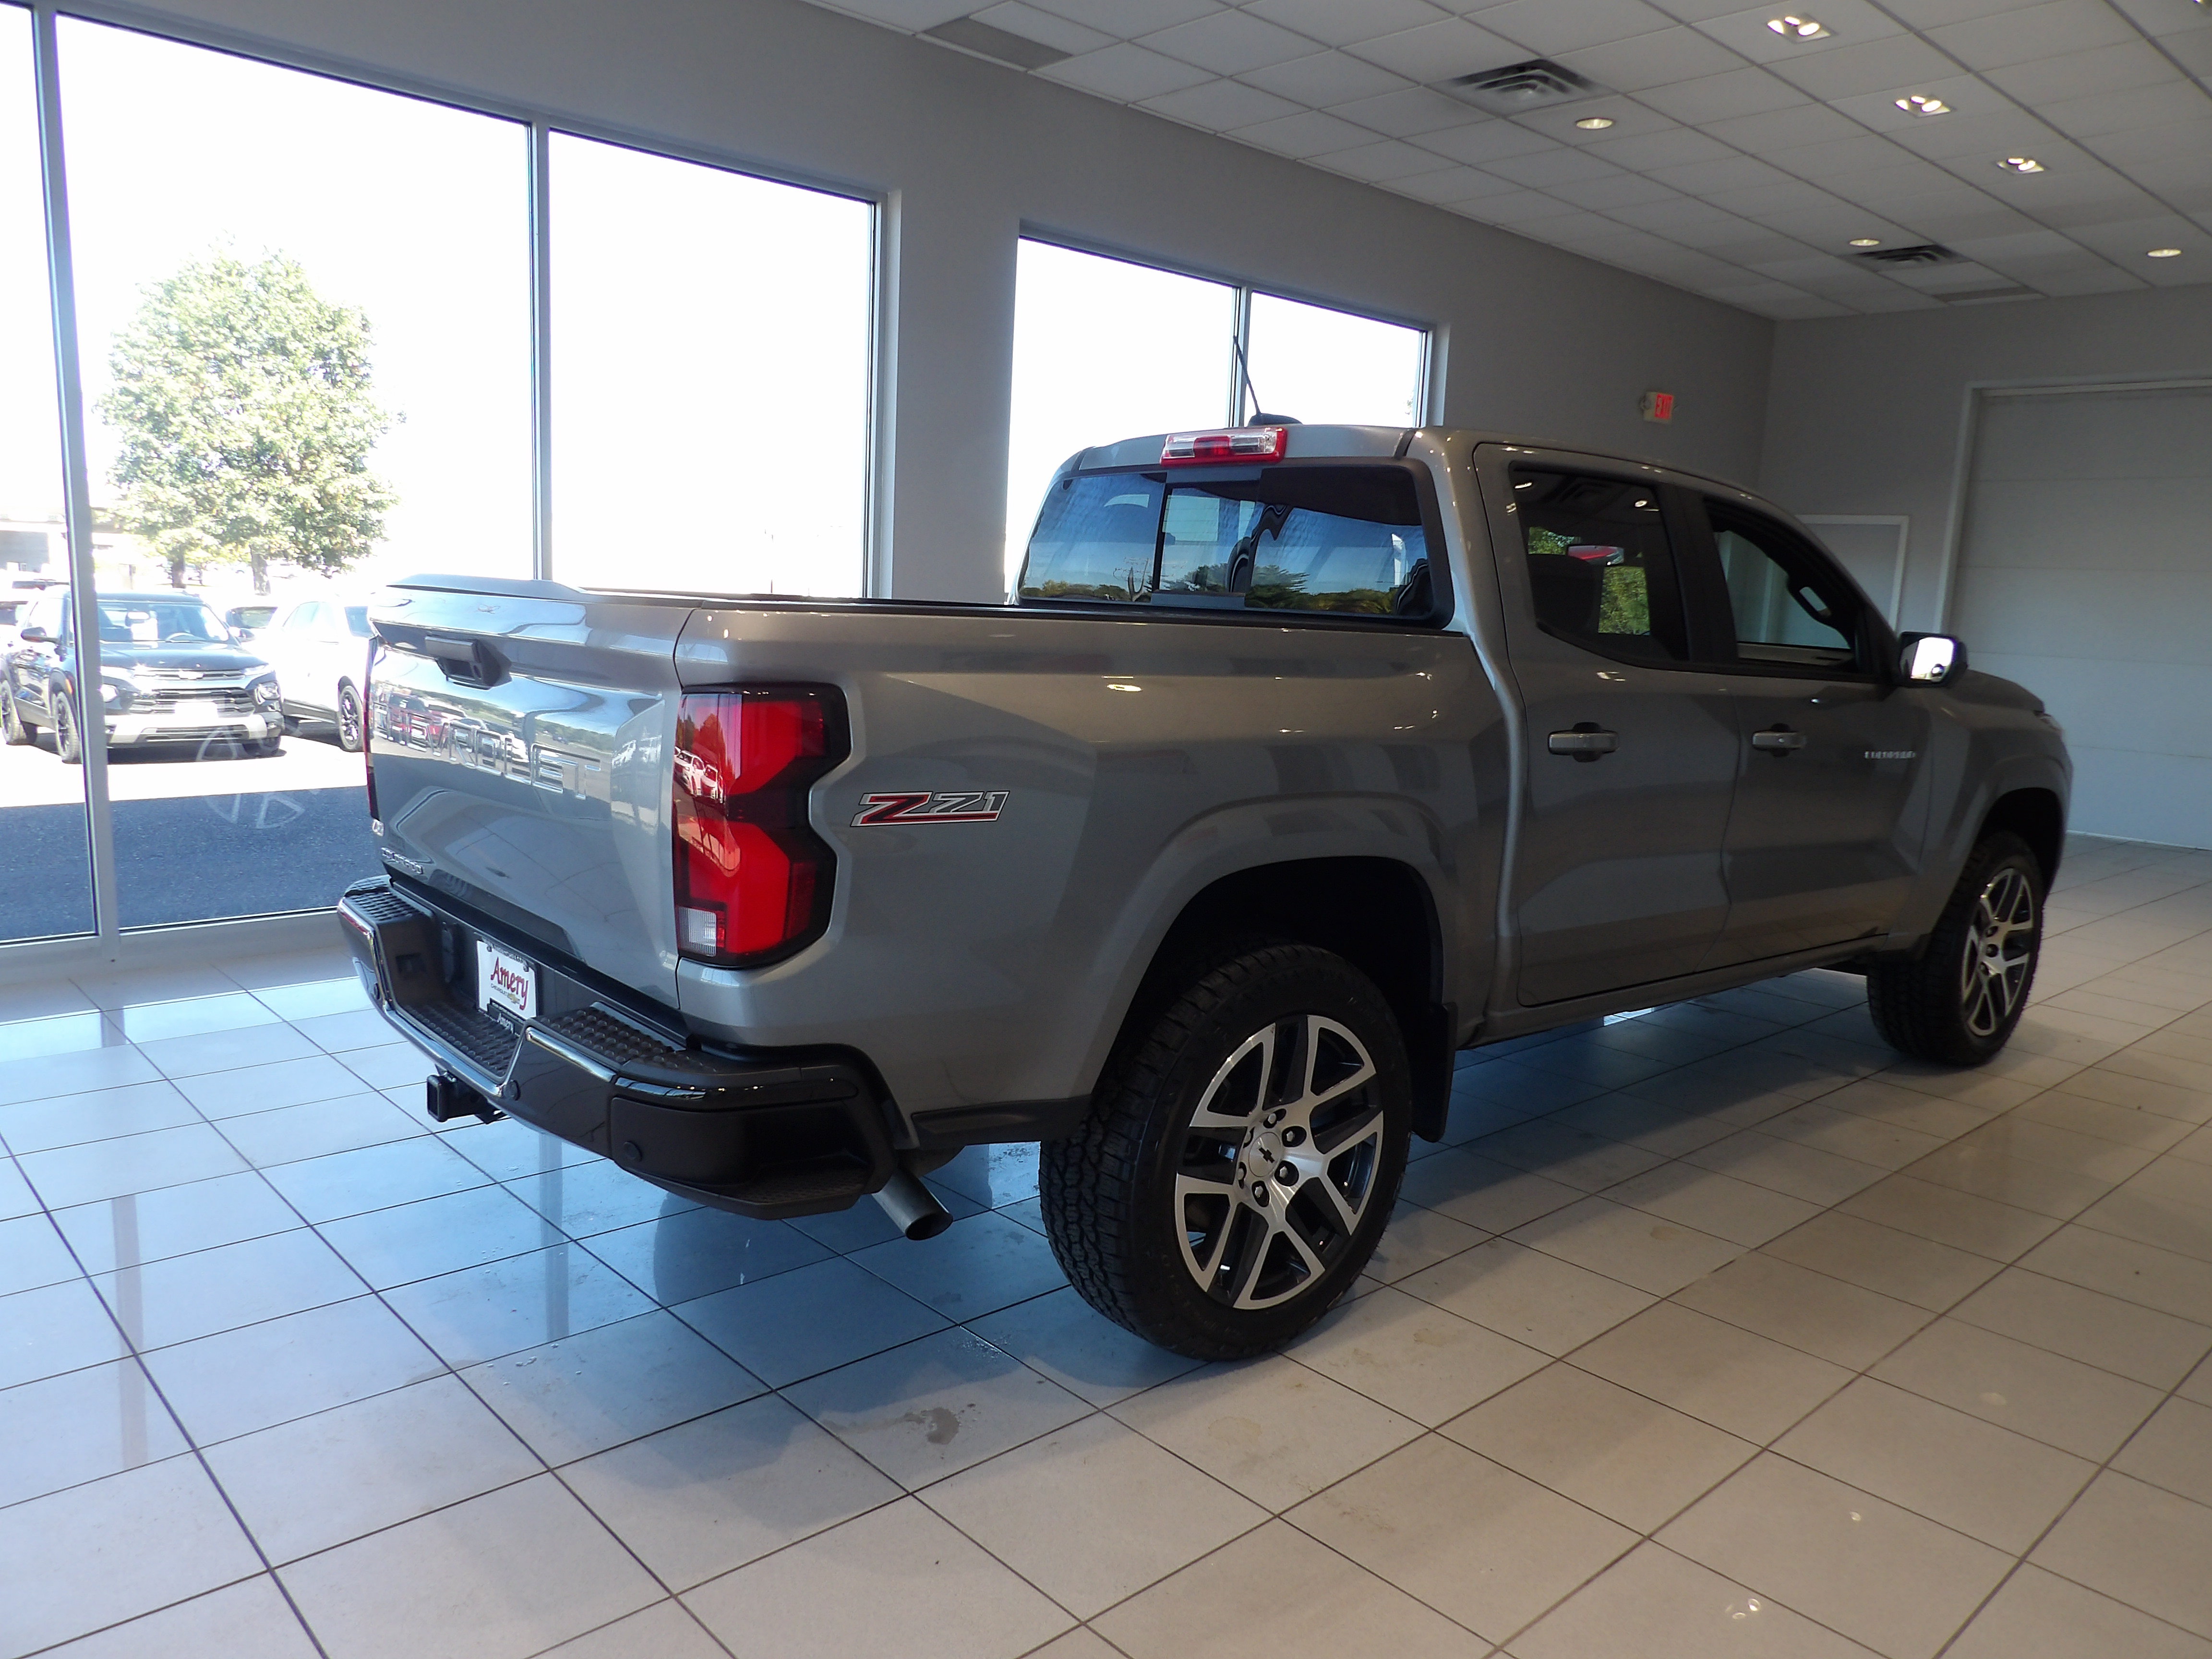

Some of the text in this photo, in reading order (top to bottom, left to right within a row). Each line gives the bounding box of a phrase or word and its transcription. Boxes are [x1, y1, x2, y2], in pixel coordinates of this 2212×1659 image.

[372, 702, 601, 800] CHEVROLET
[850, 791, 1010, 827] Z71
[490, 956, 529, 1010] Amery
